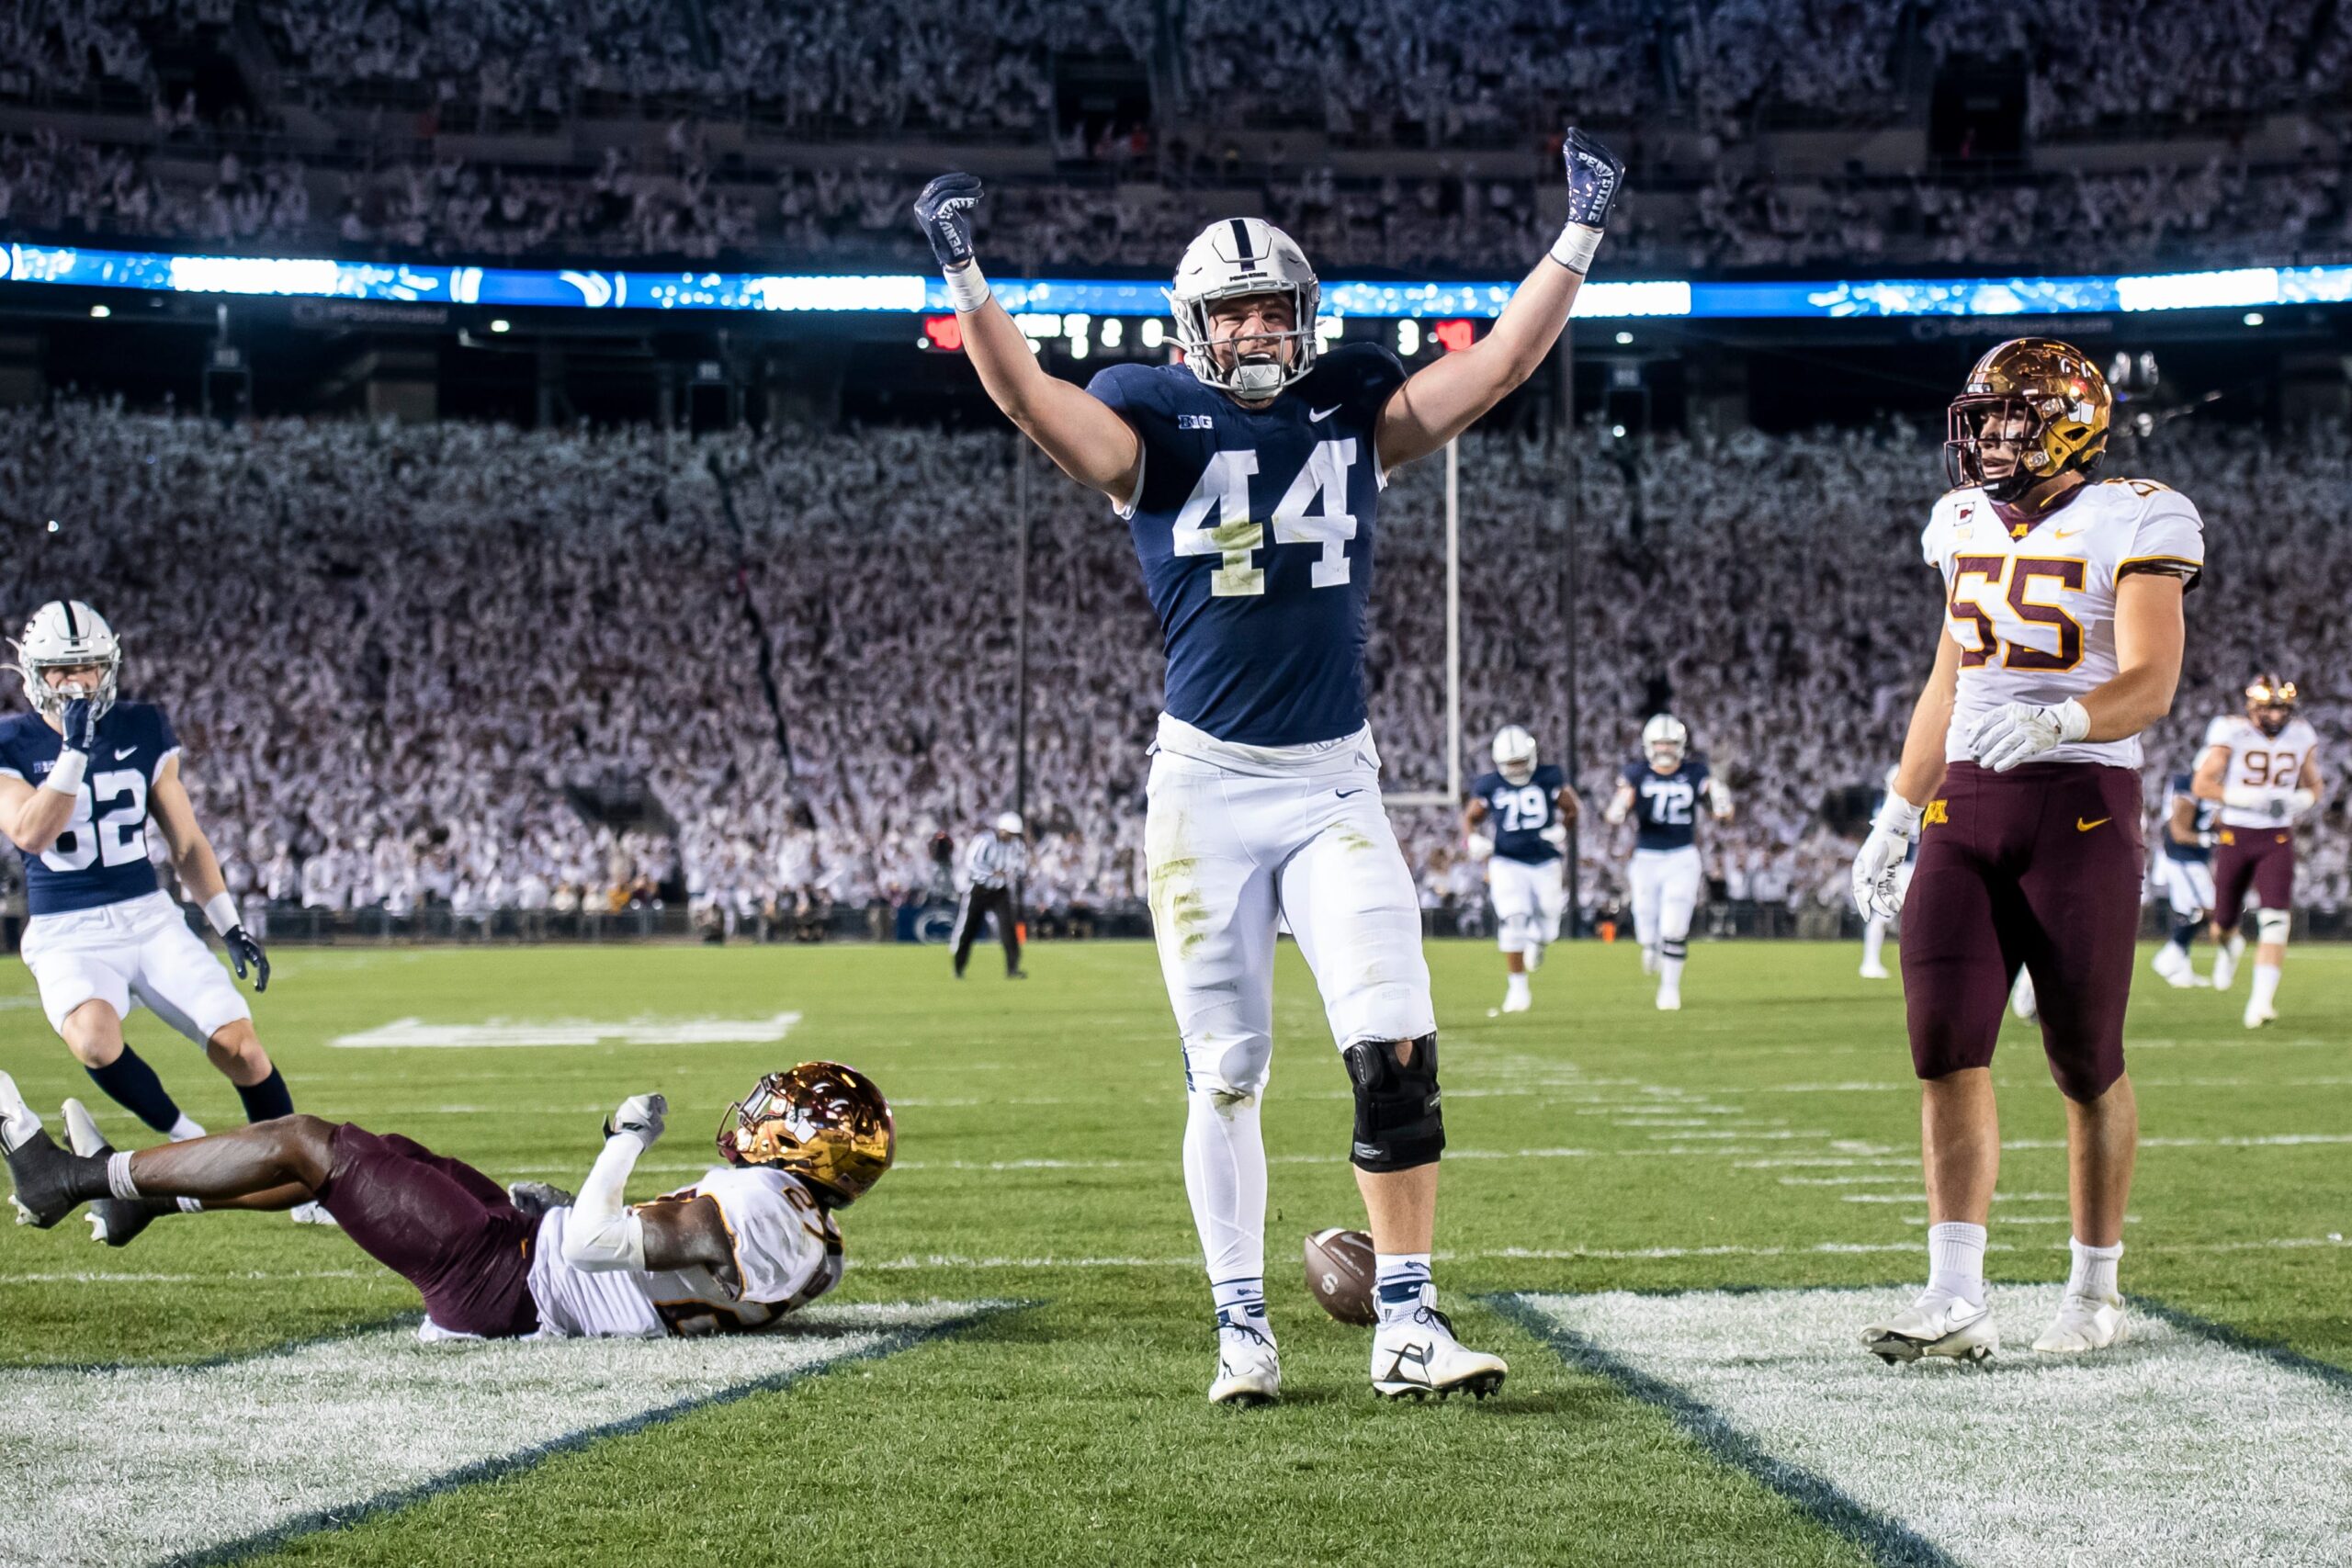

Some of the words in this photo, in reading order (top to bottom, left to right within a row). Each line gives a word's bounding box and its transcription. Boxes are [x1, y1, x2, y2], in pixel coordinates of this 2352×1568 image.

[1172, 437, 1357, 596] 44
[1948, 553, 2087, 672] 55
[2243, 750, 2296, 786] 92
[1492, 785, 1548, 831] 79
[1641, 781, 1694, 824] 72
